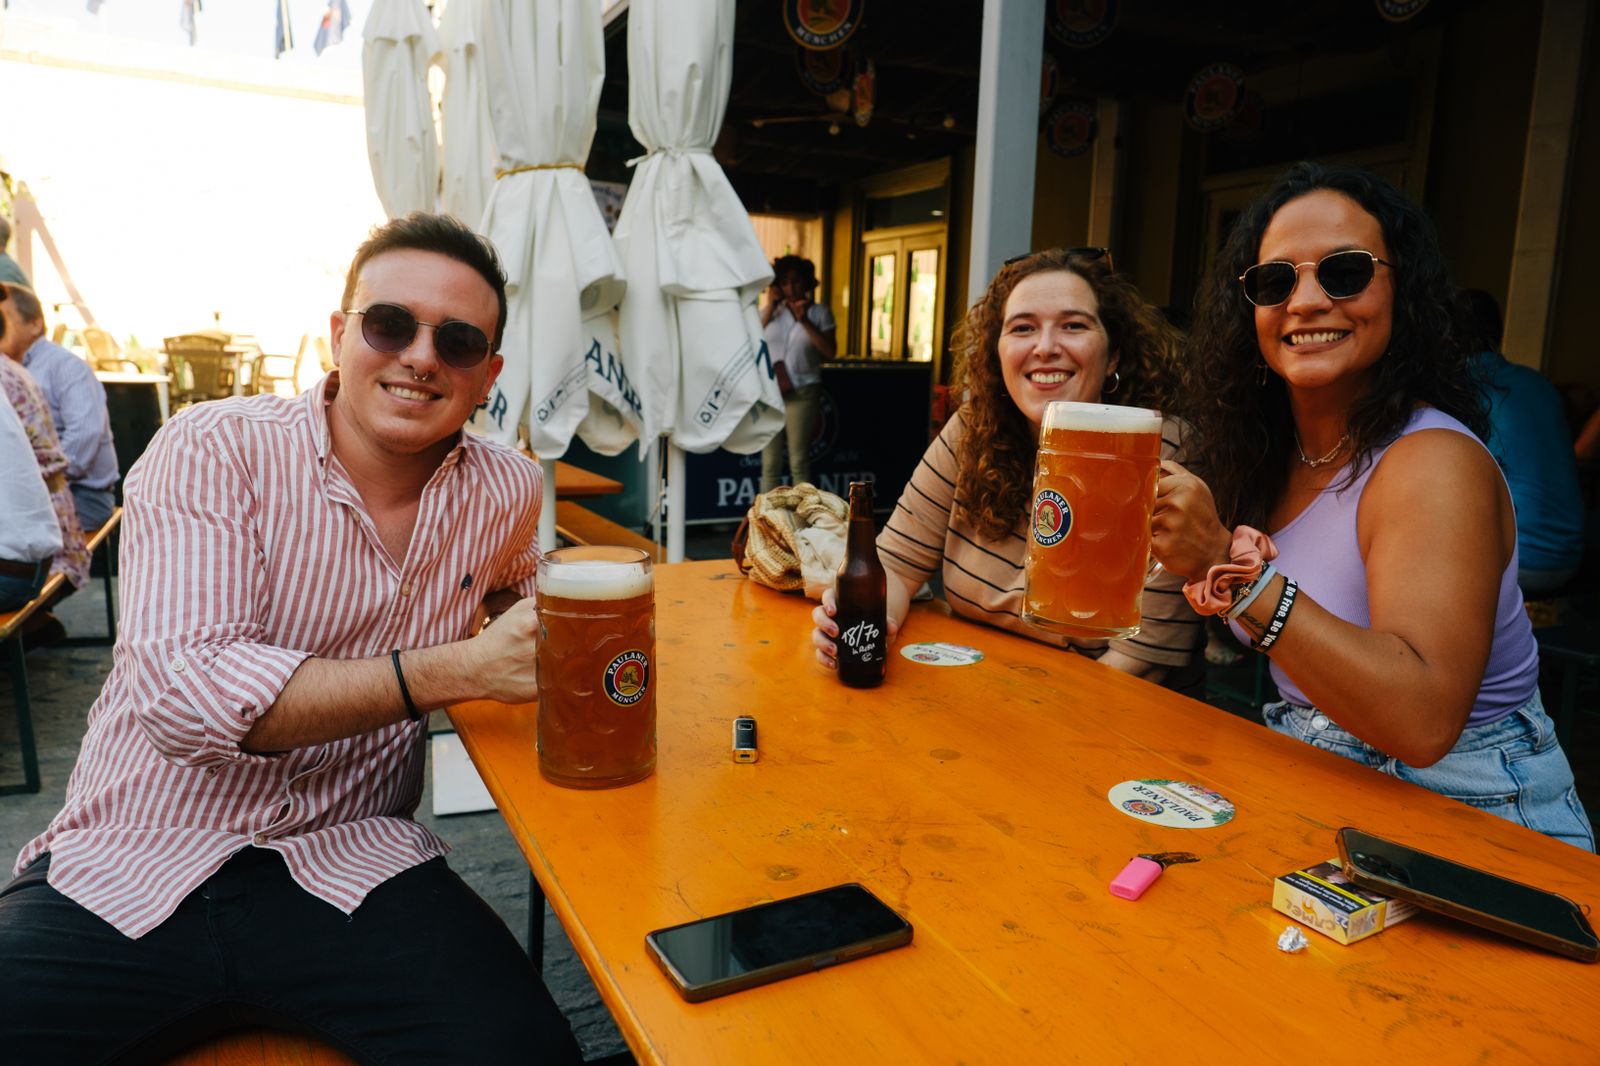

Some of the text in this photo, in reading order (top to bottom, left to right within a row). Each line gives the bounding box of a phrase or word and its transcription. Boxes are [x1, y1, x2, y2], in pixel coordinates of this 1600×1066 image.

[717, 471, 879, 507] PANER
[1034, 491, 1069, 515] PAULANER
[841, 620, 880, 648] 18/70
[607, 651, 648, 675] PAULANER
[1132, 785, 1205, 822] PAULANER
[1285, 898, 1336, 931] CAMEL
